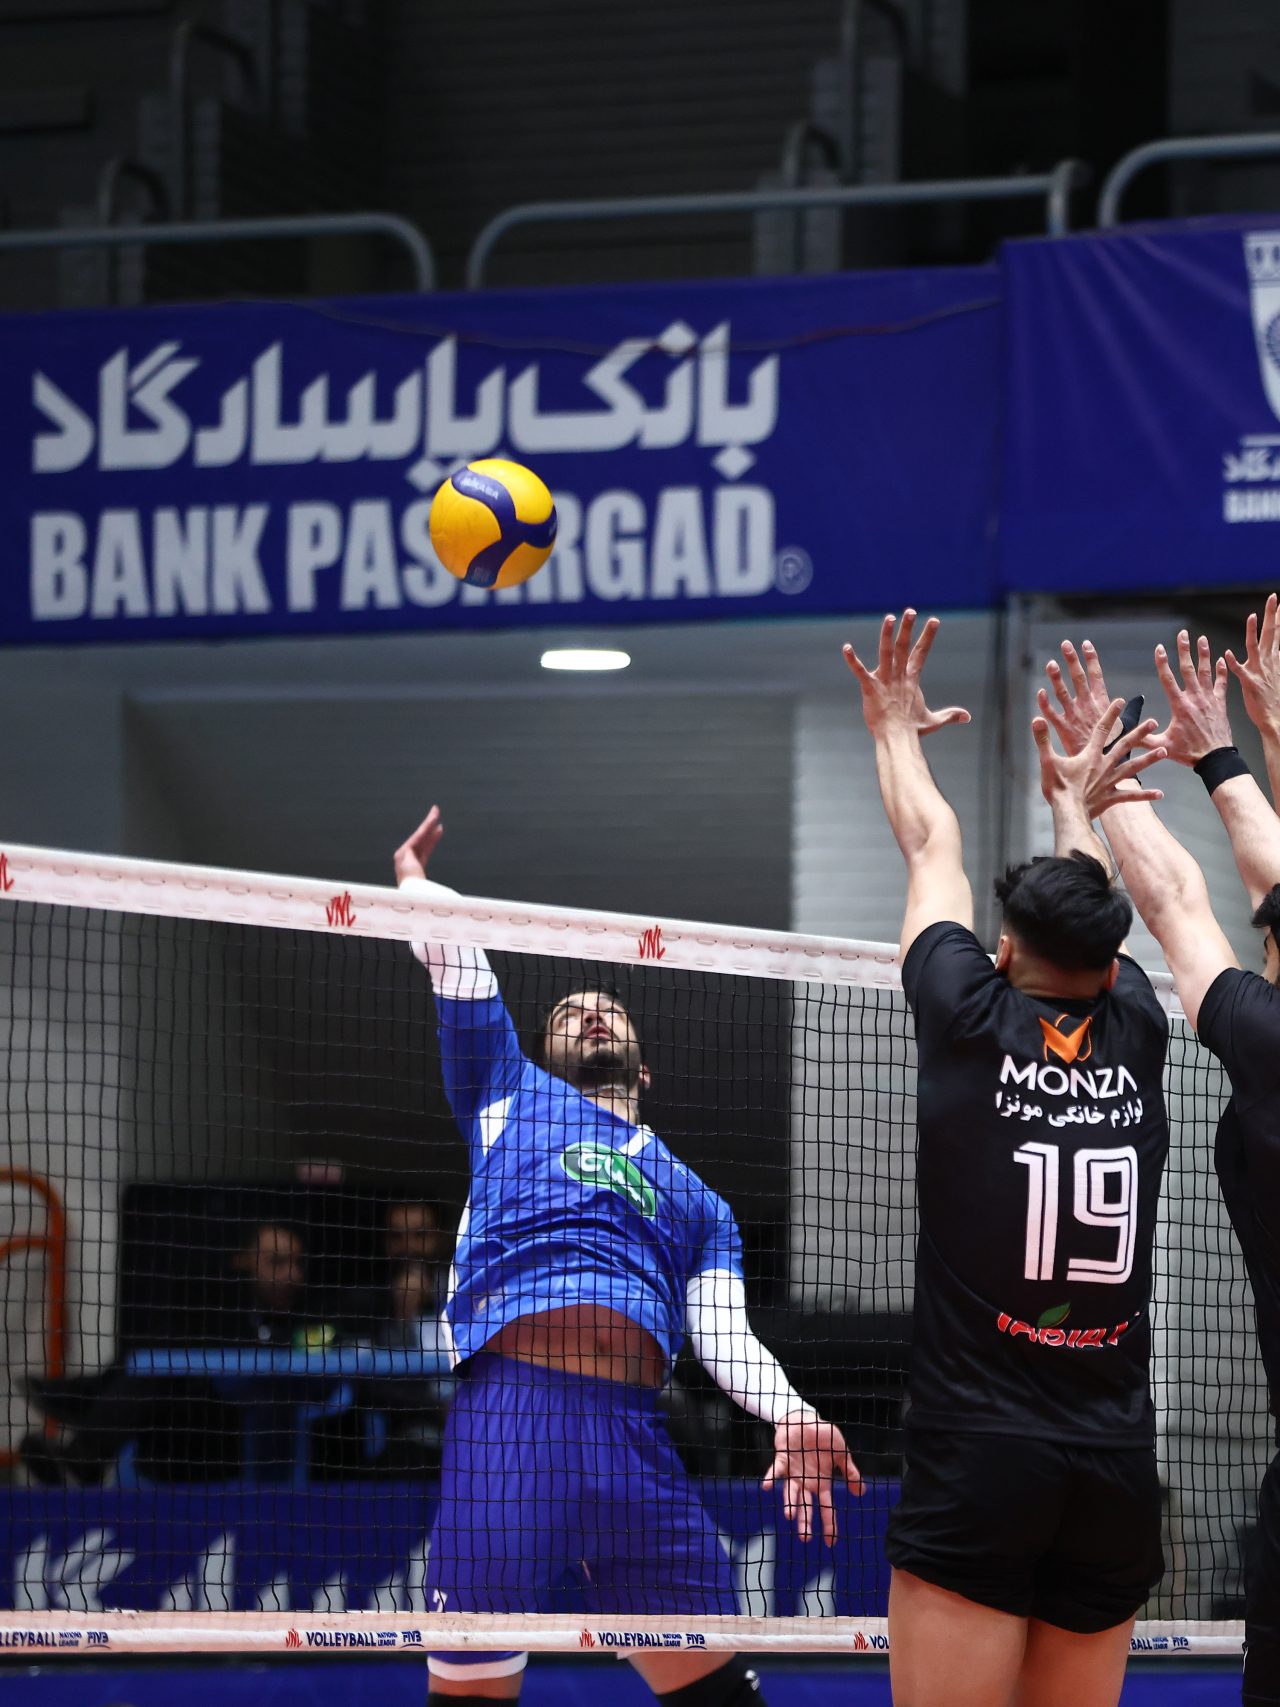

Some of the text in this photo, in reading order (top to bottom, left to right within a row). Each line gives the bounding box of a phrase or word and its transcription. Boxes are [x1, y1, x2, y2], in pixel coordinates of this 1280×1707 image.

[507, 319, 780, 481] بانک
[30, 485, 779, 621] BANK PASRGAD
[999, 1053, 1139, 1100] MONZA
[995, 1090, 1144, 1129] لوازم خانگی مونزا
[1013, 1141, 1138, 1285] 19
[0, 1631, 57, 1647] LLEYBALL
[305, 1631, 377, 1647] VOLLEYBALL
[597, 1632, 663, 1647] VOLLEYBALL
